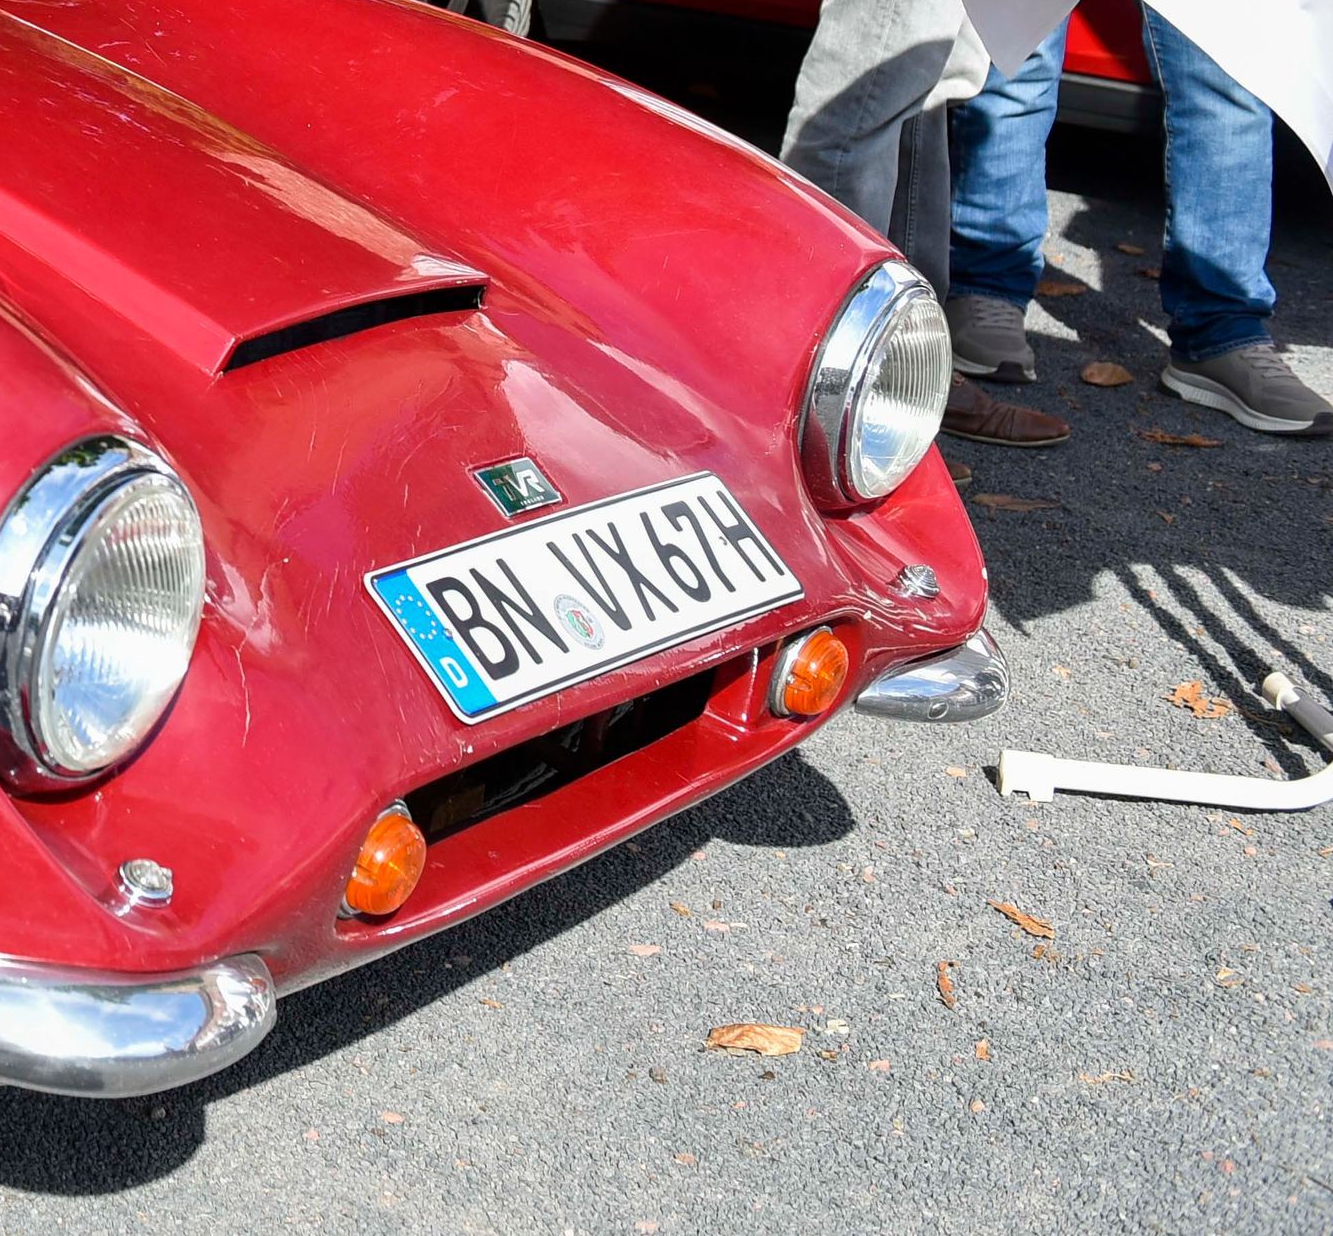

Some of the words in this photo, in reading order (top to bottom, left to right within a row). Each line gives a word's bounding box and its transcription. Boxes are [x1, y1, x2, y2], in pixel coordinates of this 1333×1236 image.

[491, 468, 546, 502] TVR
[426, 558, 570, 682] BN
[439, 656, 469, 688] D
